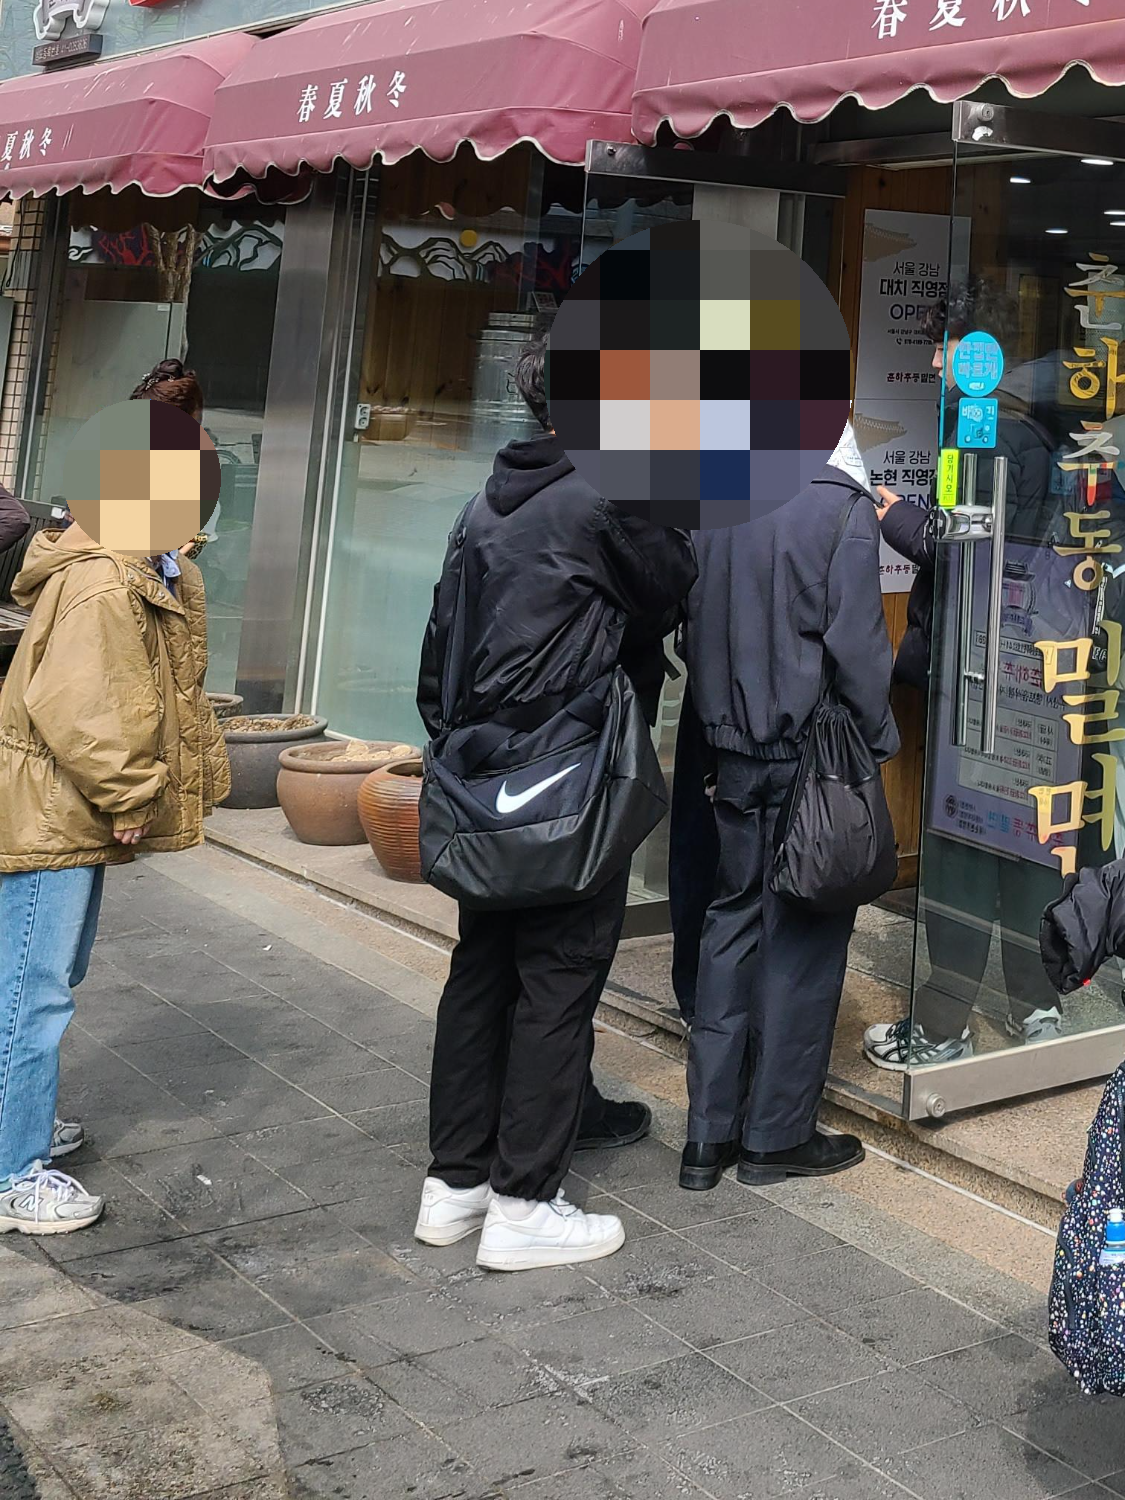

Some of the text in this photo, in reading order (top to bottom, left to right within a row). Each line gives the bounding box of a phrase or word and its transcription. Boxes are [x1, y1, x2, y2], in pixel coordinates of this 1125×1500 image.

[296, 70, 408, 123] 春夏秋冬
[893, 262, 940, 277] 서울 강남
[880, 278, 907, 297] 대치
[890, 304, 928, 321] OPE
[883, 451, 931, 465] 서울 강남
[870, 469, 897, 487] 논현
[945, 454, 954, 494] 당기시오
